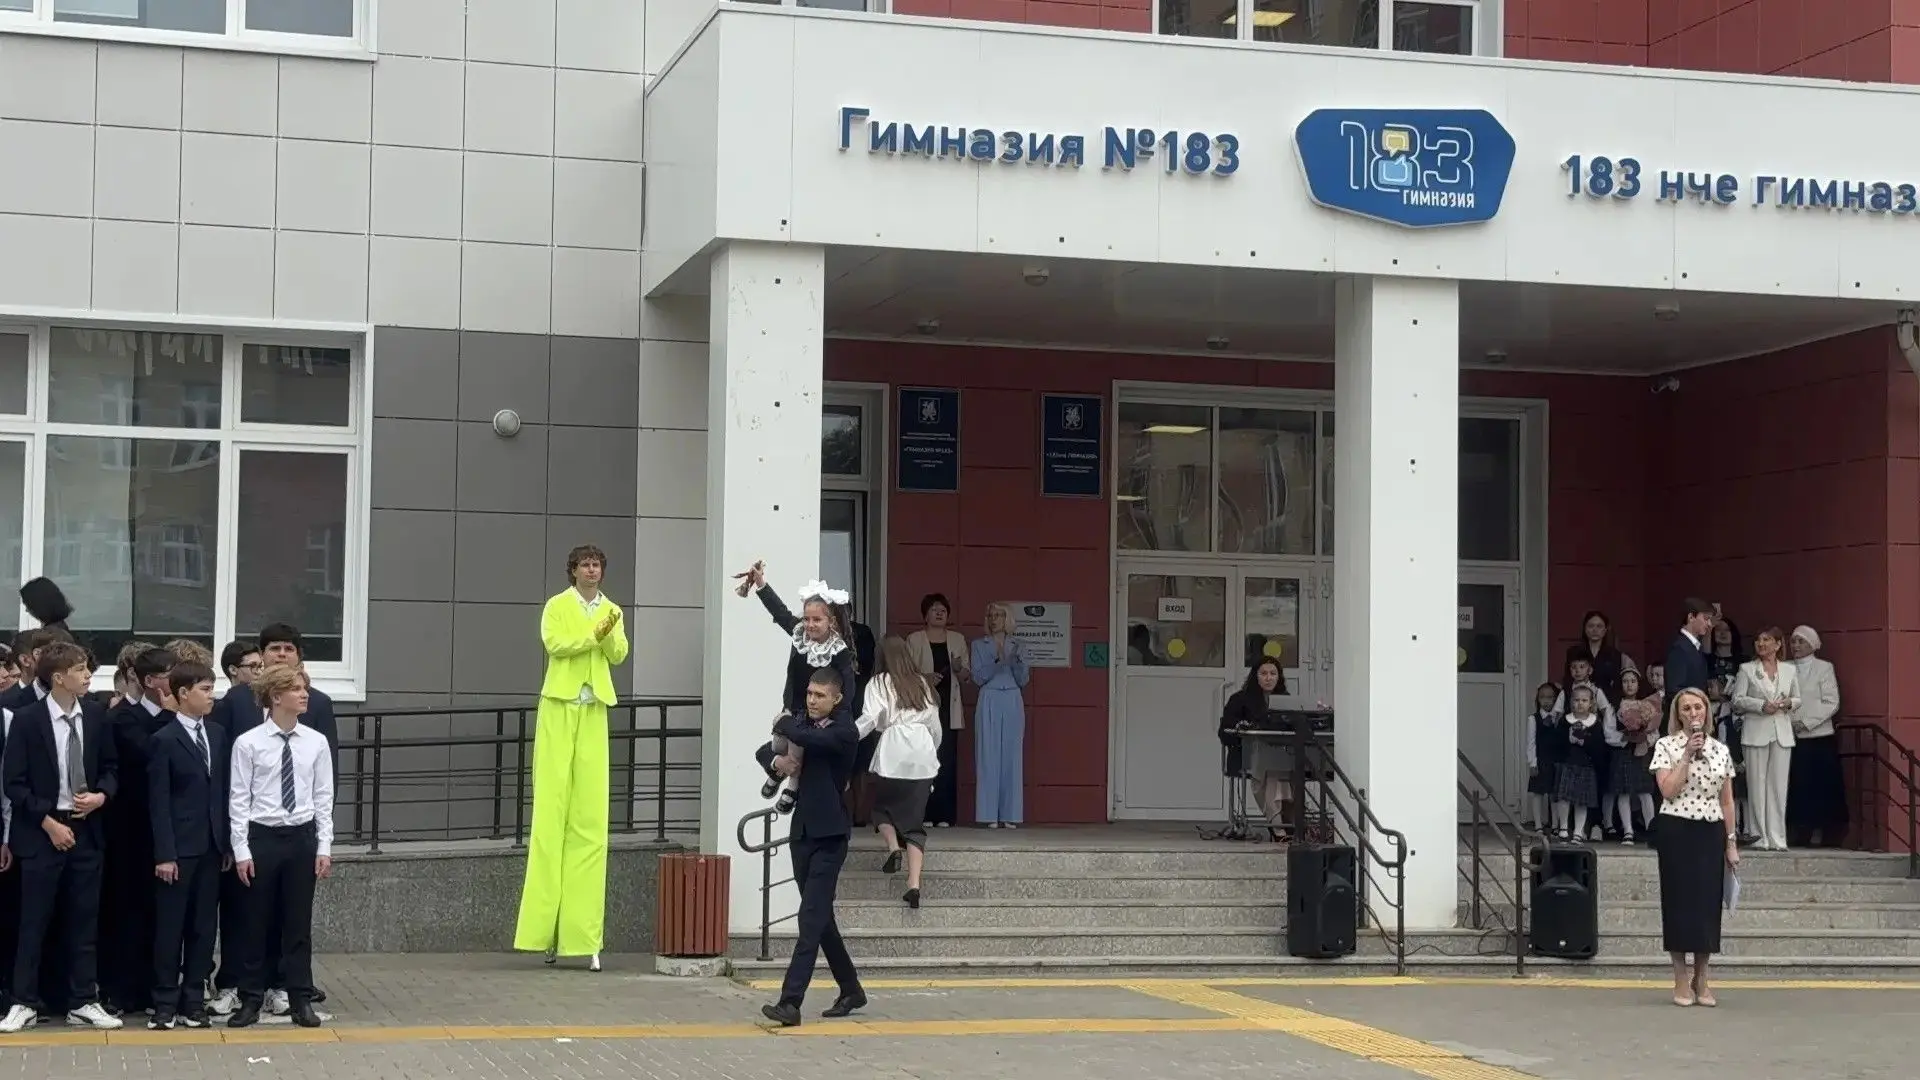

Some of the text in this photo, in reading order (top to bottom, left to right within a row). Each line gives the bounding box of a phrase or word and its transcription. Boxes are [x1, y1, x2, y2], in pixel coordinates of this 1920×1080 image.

[839, 106, 1240, 175] Гимназия №183
[1341, 121, 1474, 193] 183
[1561, 154, 1920, 214] 183 нче гимназ
[1165, 605, 1185, 613] ВХОД
